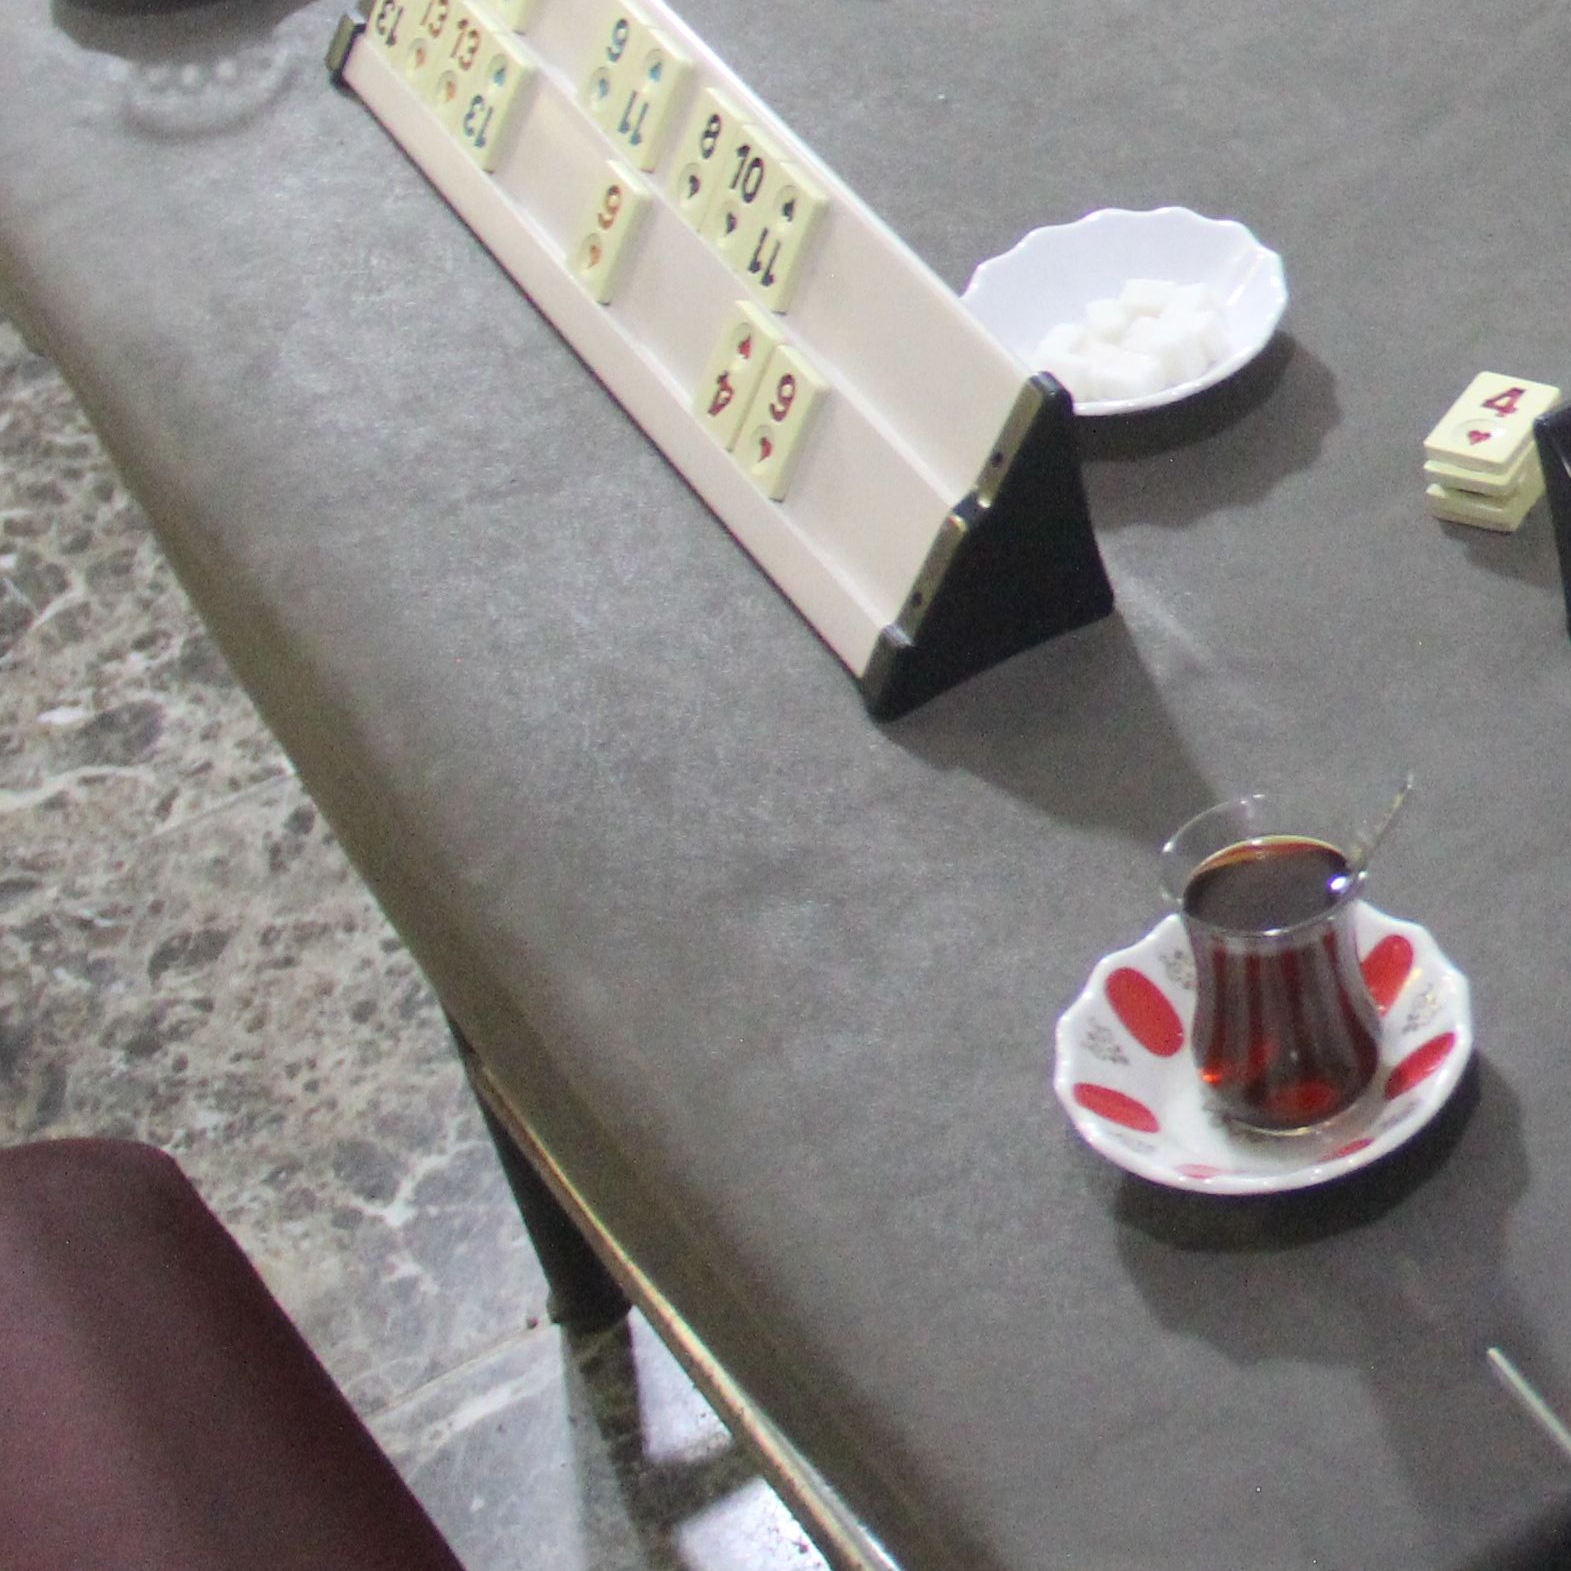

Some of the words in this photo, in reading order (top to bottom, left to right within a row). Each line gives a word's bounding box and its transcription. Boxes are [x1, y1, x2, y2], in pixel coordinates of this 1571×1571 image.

[449, 17, 480, 71] 13
[617, 89, 649, 145] 11
[700, 113, 722, 159] 8
[729, 143, 765, 203] 10
[747, 227, 781, 287] 11
[1482, 387, 1526, 418] 4
